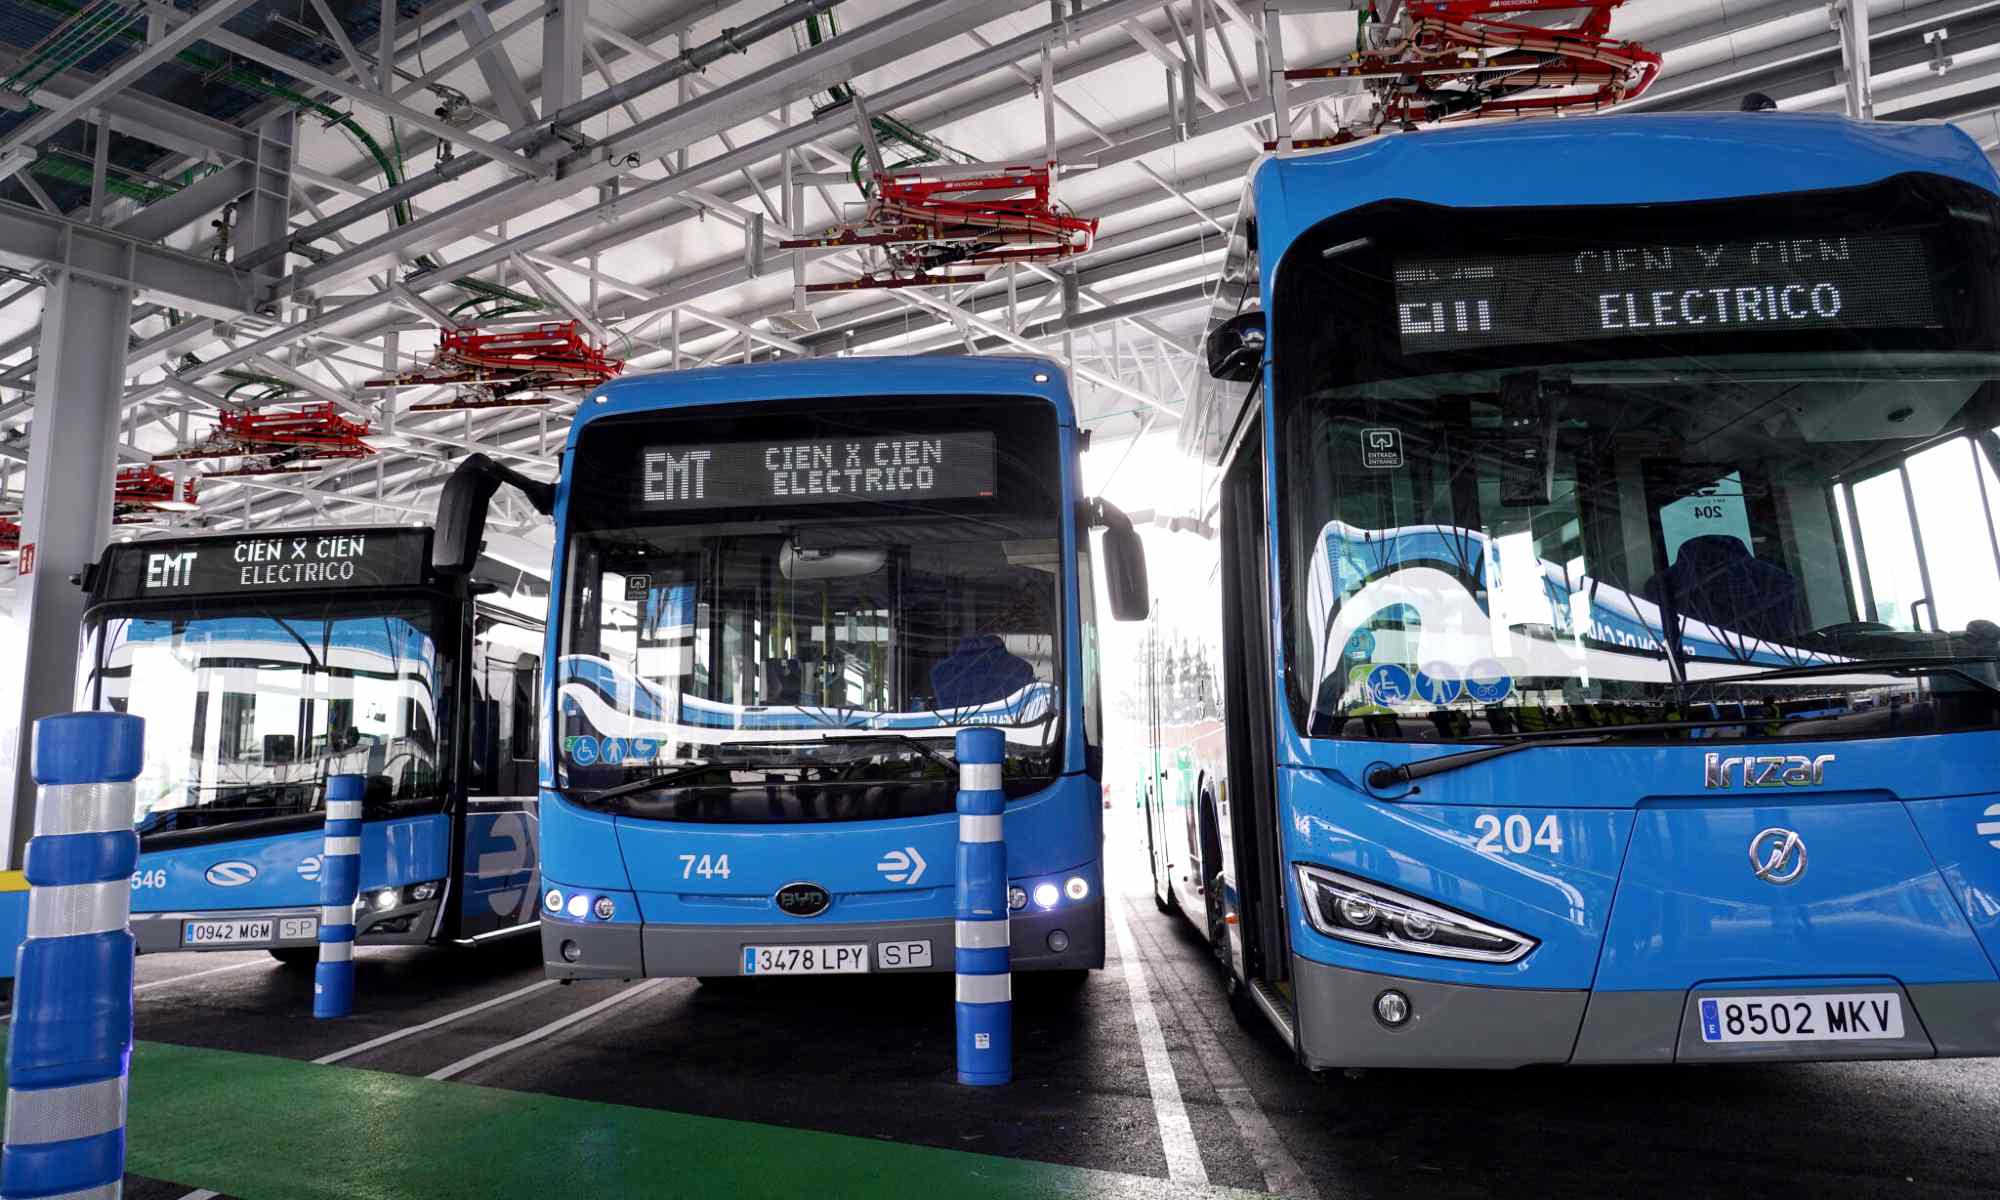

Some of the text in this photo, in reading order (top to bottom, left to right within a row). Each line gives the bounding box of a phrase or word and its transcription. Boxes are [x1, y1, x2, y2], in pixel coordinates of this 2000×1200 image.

[1599, 282, 1842, 329] ELECTRICO
[764, 440, 943, 470] CIEN X CIEN
[644, 450, 712, 501] EMT
[773, 465, 934, 495] ELECTRICO
[233, 536, 365, 563] CIEN X CIEN
[146, 551, 198, 588] EMT
[240, 560, 355, 585] ELECTRICO
[1704, 752, 1836, 788] Irizar
[1474, 813, 1564, 854] 204
[679, 854, 731, 880] 744
[196, 924, 234, 940] 0942
[239, 923, 270, 938] MGM
[284, 921, 312, 937] SP
[760, 947, 864, 970] 3478 LPY
[885, 943, 925, 965] SP
[1725, 1000, 1889, 1036] 8502 MKV
